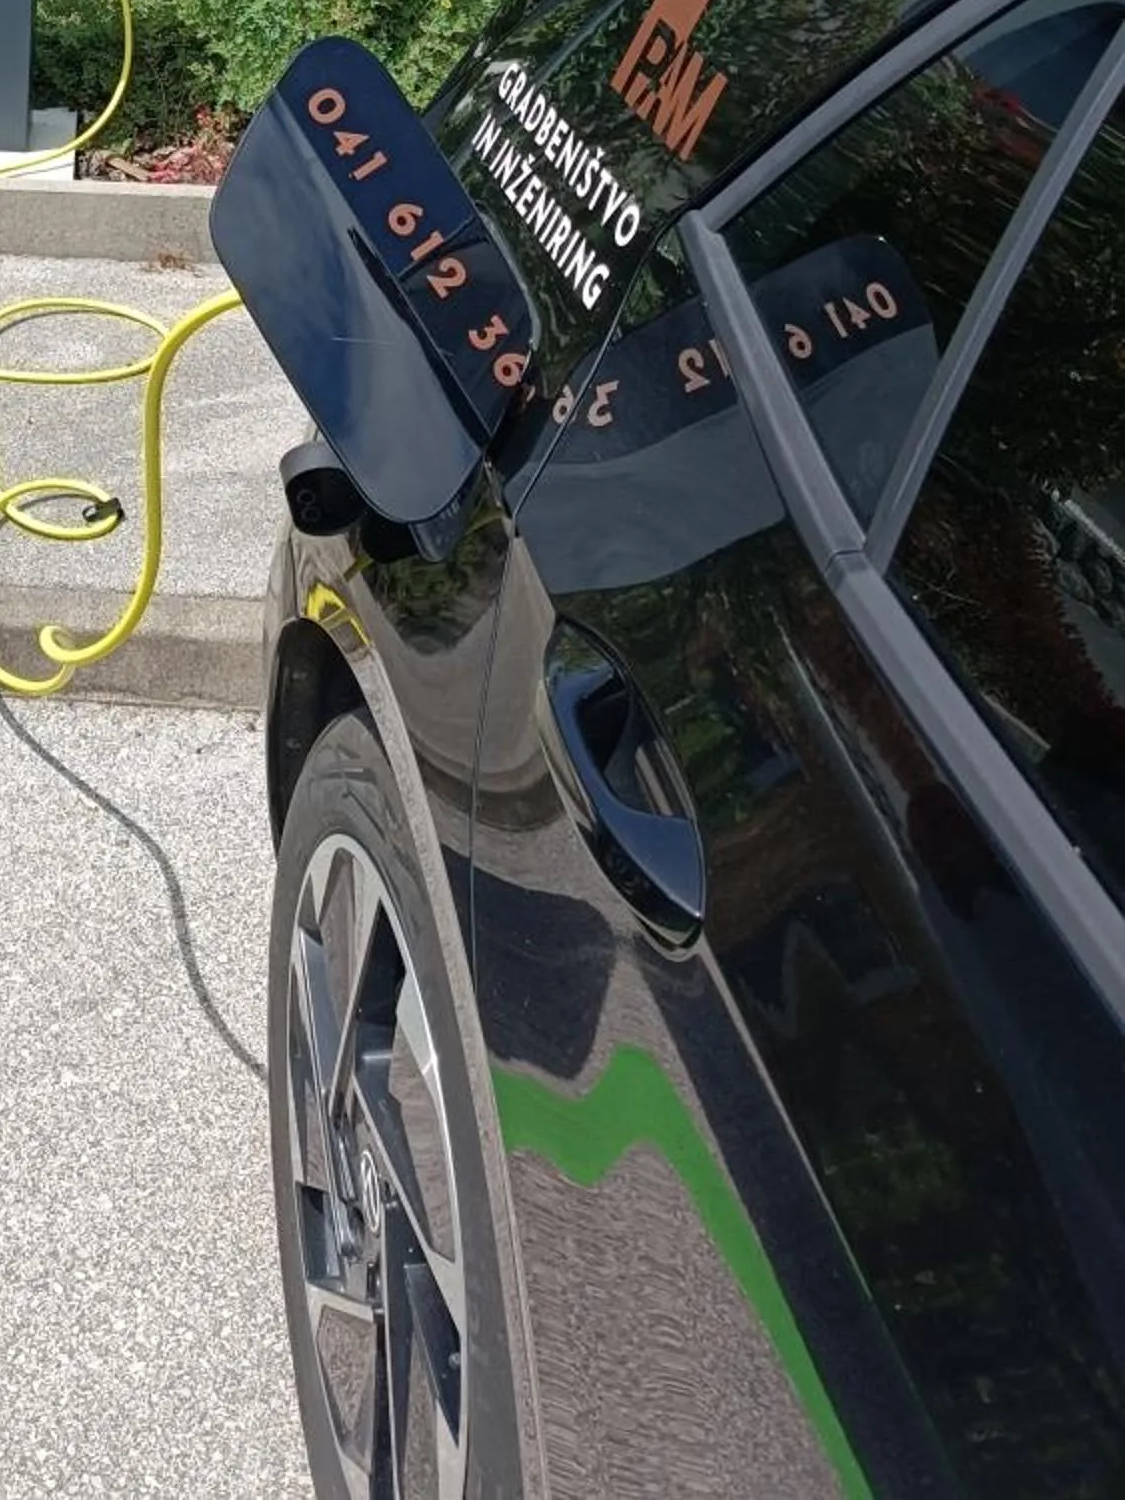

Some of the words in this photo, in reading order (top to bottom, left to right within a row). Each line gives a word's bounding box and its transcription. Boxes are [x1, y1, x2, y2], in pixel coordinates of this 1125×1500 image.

[308, 88, 387, 181] 041
[387, 203, 467, 299] 612
[472, 113, 502, 161] IN
[489, 139, 610, 310] INŽENIRING
[498, 63, 640, 247] GRADBENIŠTVO
